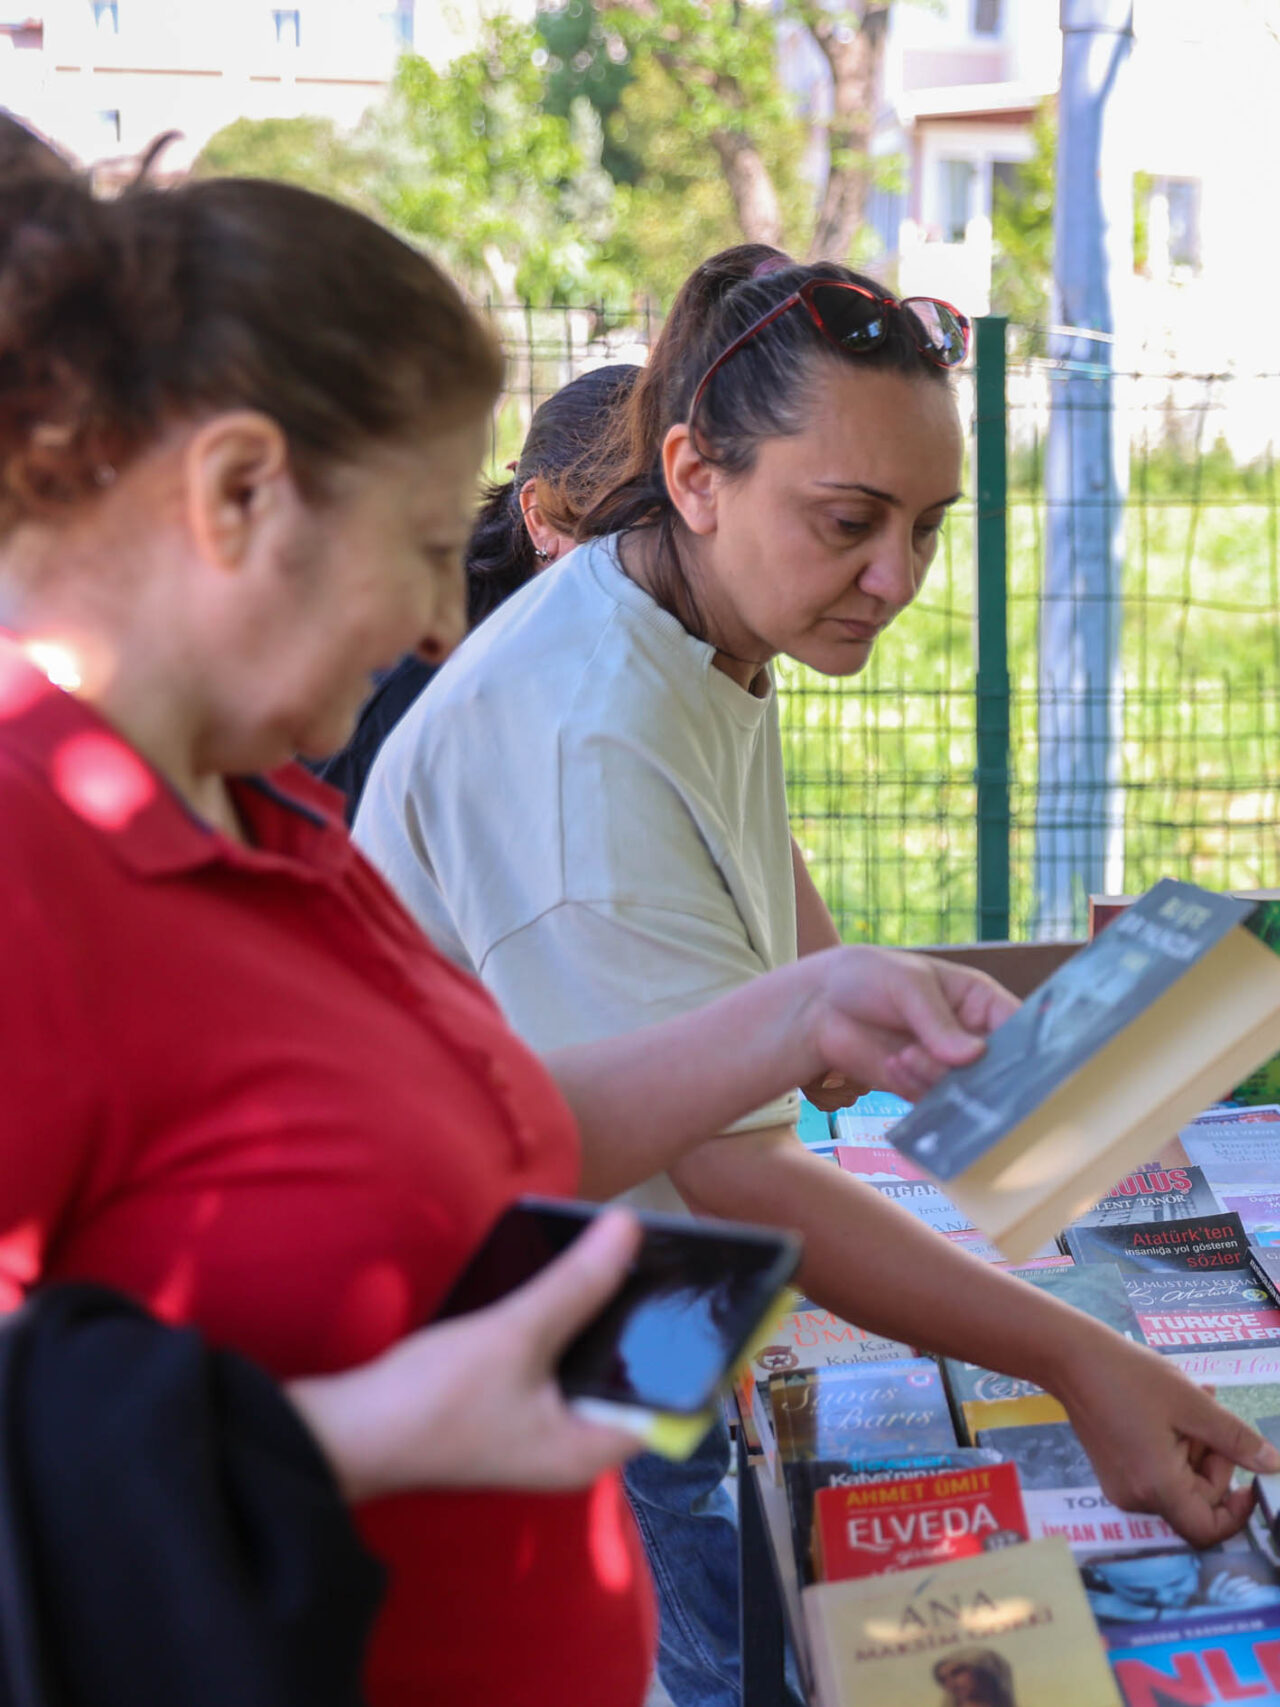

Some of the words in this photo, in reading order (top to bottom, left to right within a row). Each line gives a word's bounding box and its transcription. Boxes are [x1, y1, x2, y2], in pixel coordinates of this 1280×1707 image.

[1133, 1223, 1235, 1247] Atatürk'ten
[1125, 1244, 1174, 1258] insanlığa
[1173, 1243, 1191, 1256] yol
[1192, 1239, 1238, 1254] gösteren
[1186, 1251, 1242, 1270] sözler
[1143, 1279, 1217, 1290] MUSTAFA
[1218, 1277, 1259, 1288] KEMAL
[858, 1340, 897, 1353] Kar
[846, 1482, 925, 1506] AHMET
[934, 1471, 992, 1498] ÜMİT
[847, 1502, 999, 1552] ELVEDA
[1100, 1522, 1125, 1542] NE
[1126, 1517, 1155, 1539] İLE
[900, 1588, 998, 1629] ANA
